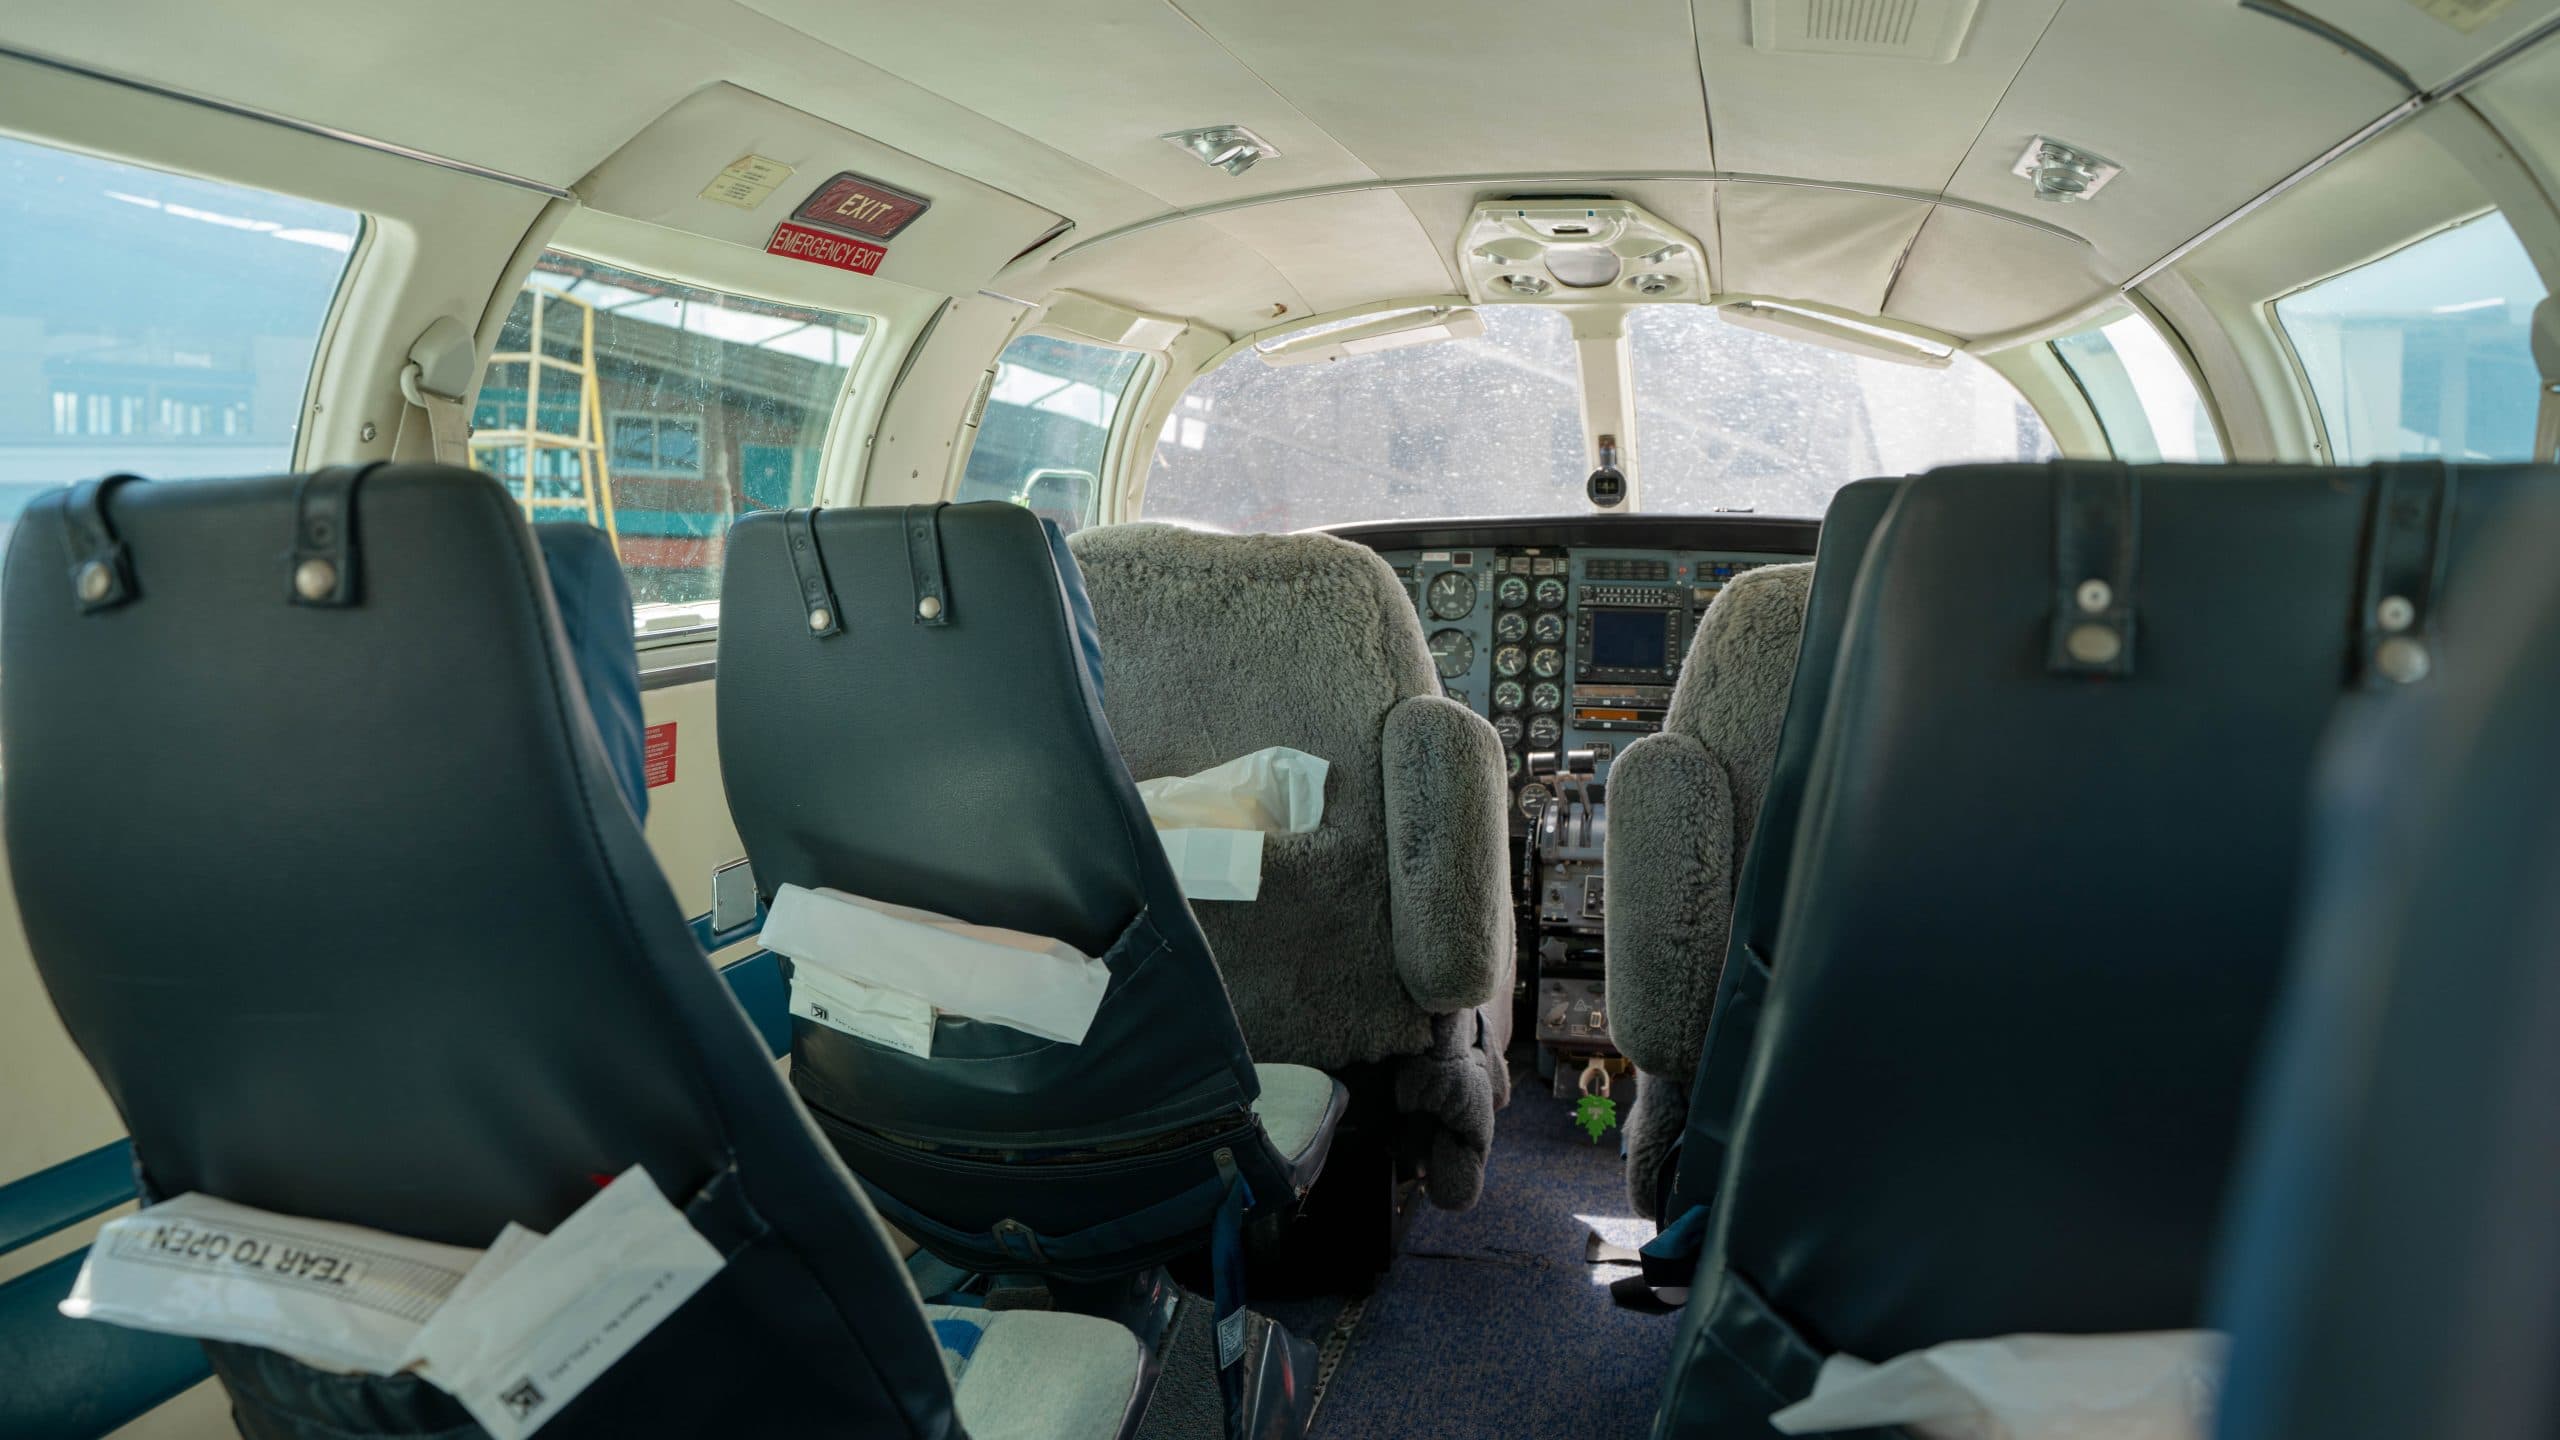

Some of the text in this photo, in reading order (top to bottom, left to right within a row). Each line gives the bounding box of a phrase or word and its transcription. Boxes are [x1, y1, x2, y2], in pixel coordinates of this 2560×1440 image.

[836, 193, 893, 222] EXIT
[772, 229, 882, 270] EMERGENCY EXIT
[151, 1224, 352, 1284] TEAR TO OPEN
